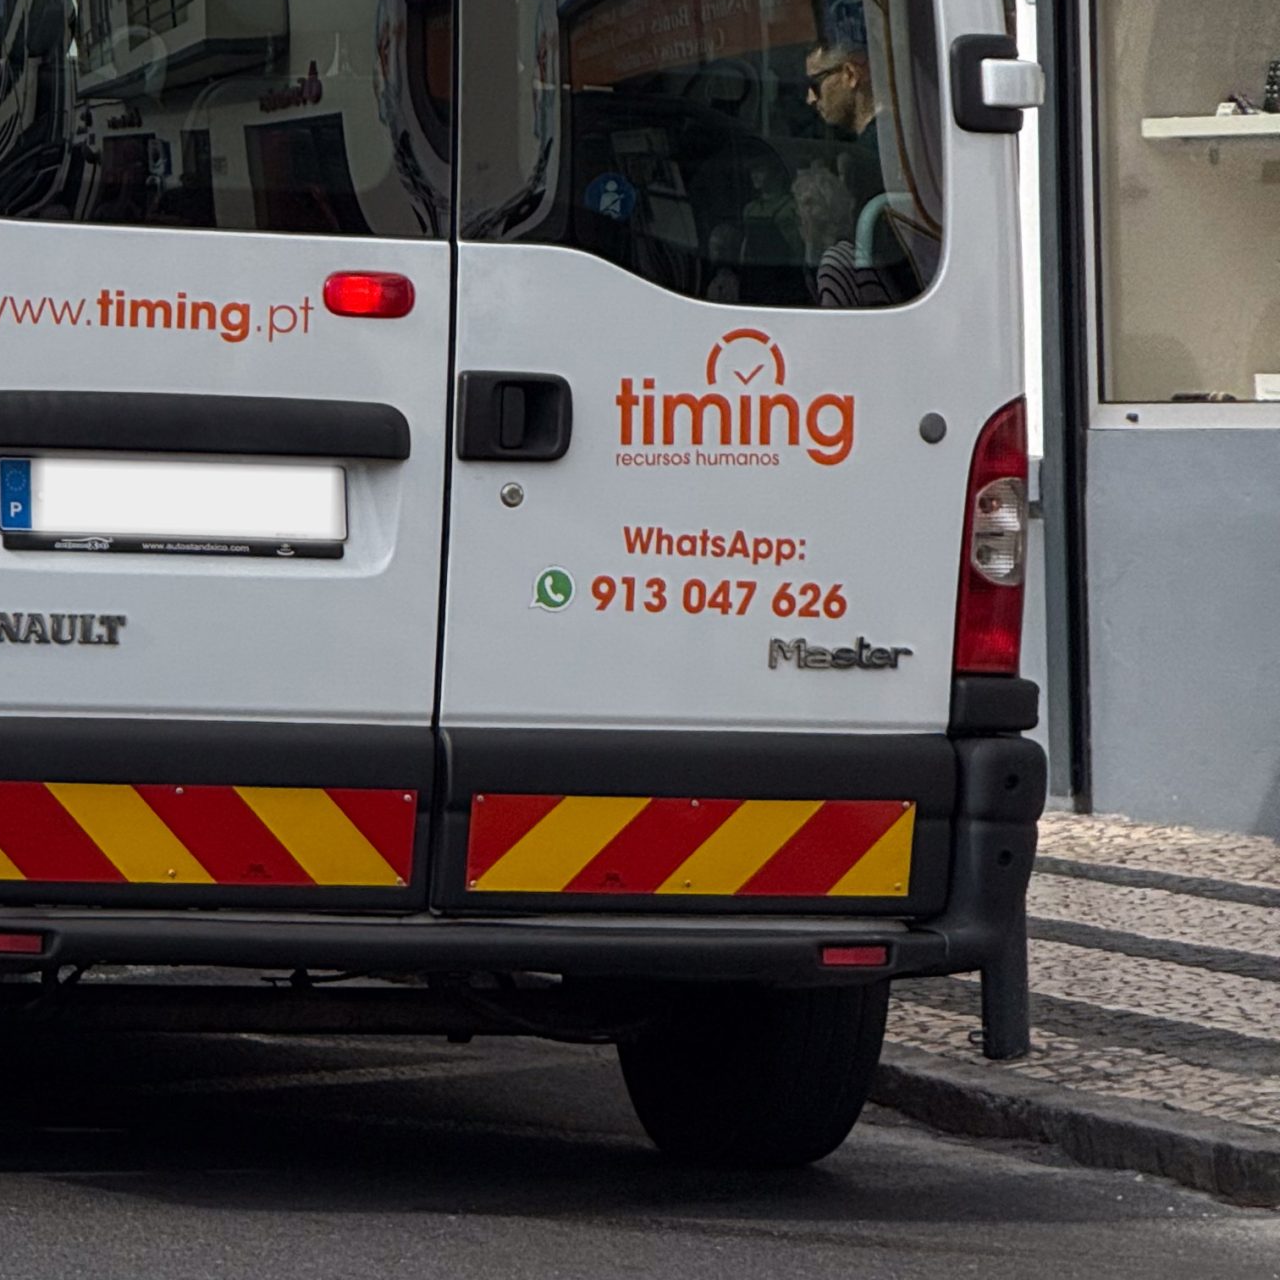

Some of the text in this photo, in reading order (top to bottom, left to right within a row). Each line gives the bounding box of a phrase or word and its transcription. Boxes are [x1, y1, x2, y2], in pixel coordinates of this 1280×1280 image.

[615, 377, 855, 466] timing
[615, 449, 780, 467] recursos humanos
[9, 502, 22, 518] P
[623, 526, 807, 566] WhatsApp:
[590, 575, 848, 619] 913 047 626
[768, 636, 914, 671] Master
